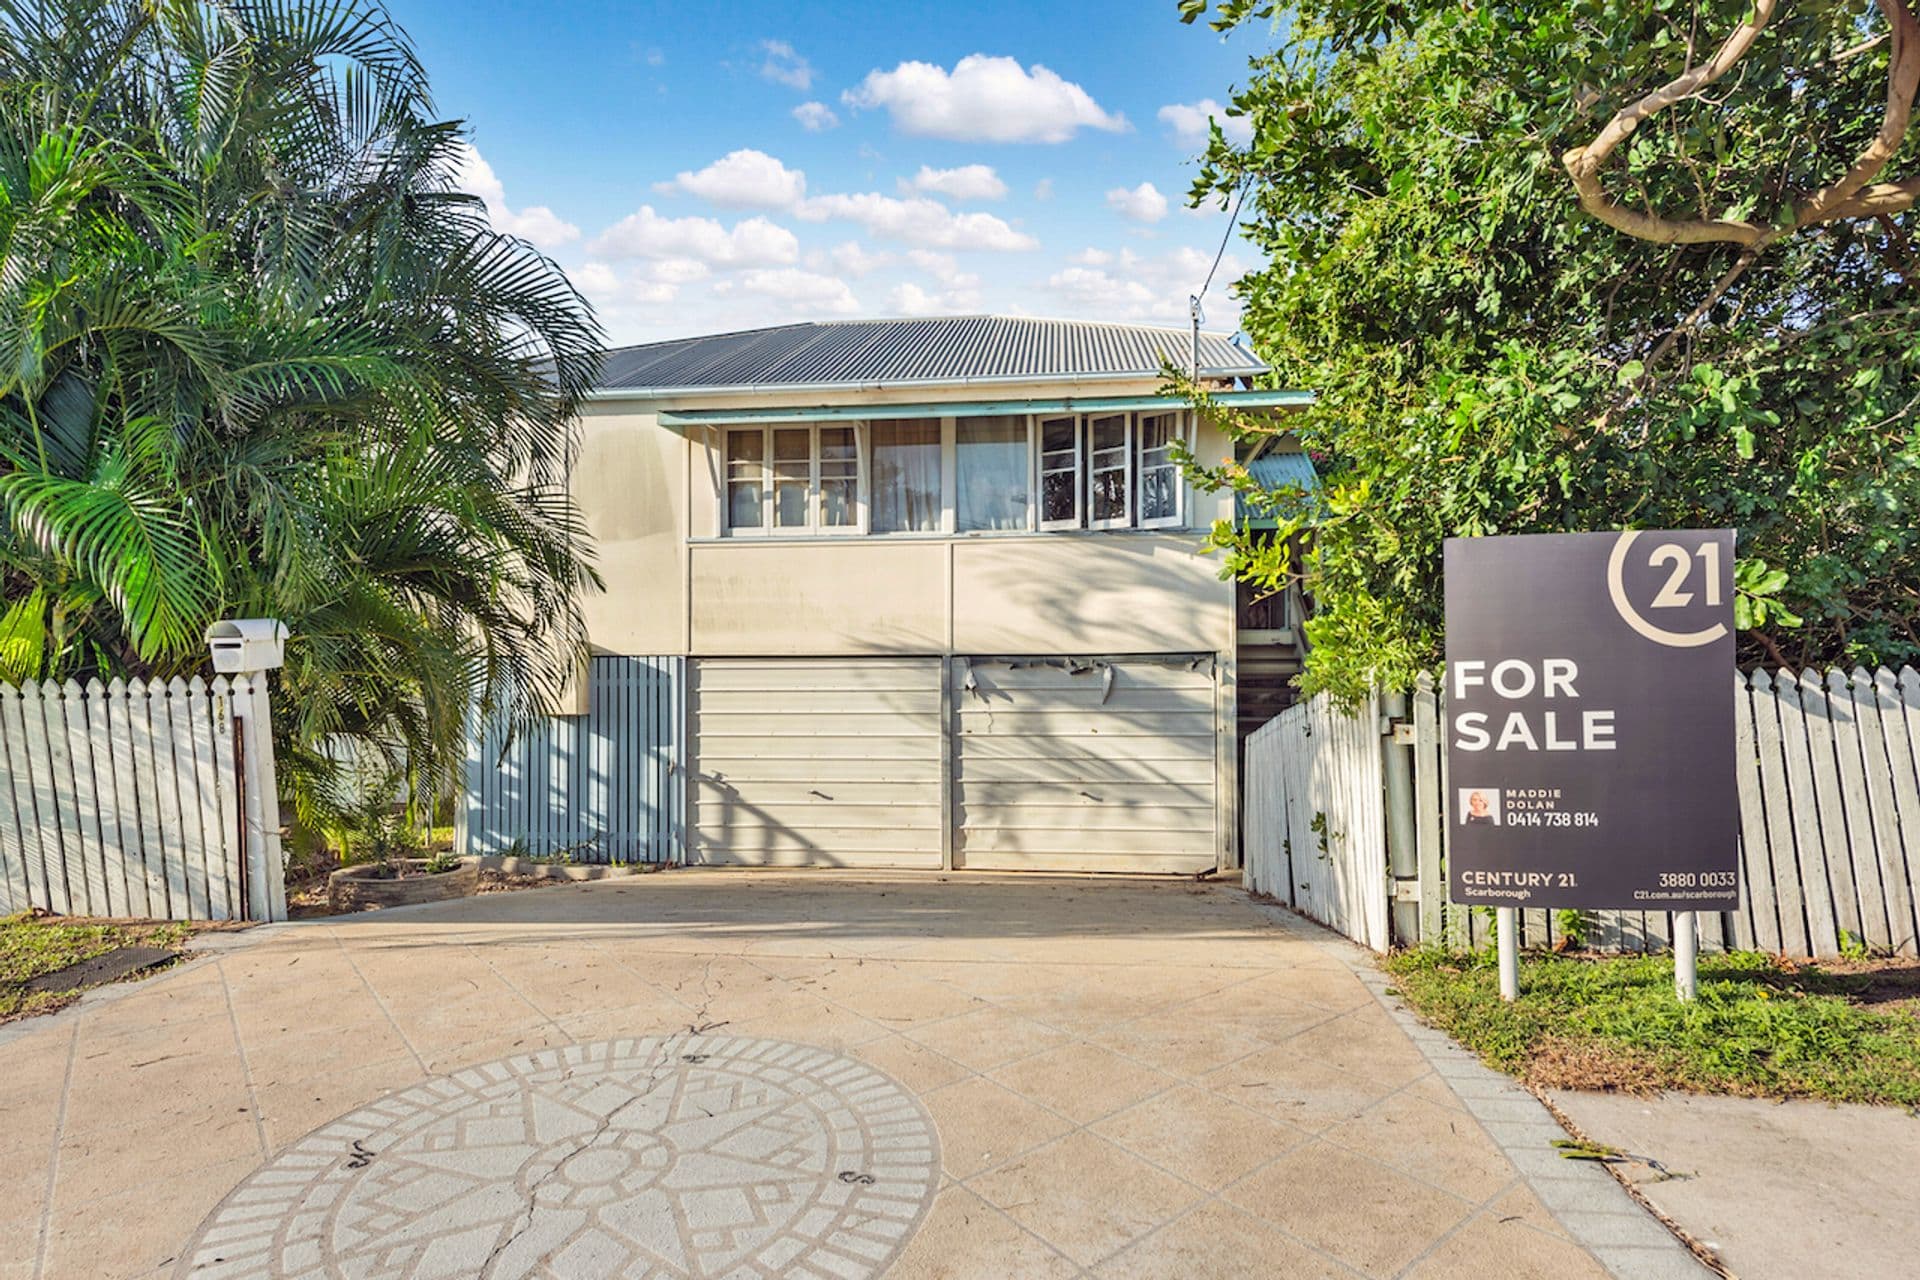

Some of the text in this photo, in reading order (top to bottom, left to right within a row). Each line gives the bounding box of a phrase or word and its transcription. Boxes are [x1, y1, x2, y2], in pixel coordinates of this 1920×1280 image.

[1454, 659, 1580, 699] FOR
[1455, 710, 1617, 751] SALE
[1506, 789, 1561, 798] MADDIE
[1506, 801, 1555, 809] DOLAN
[1507, 812, 1599, 826] 0414 738 814
[1461, 871, 1553, 887] CENTURY
[1659, 872, 1736, 887] 3880 0033
[1465, 887, 1531, 900] Scarborough
[1633, 890, 1737, 900] C21.com.au/scarborough
